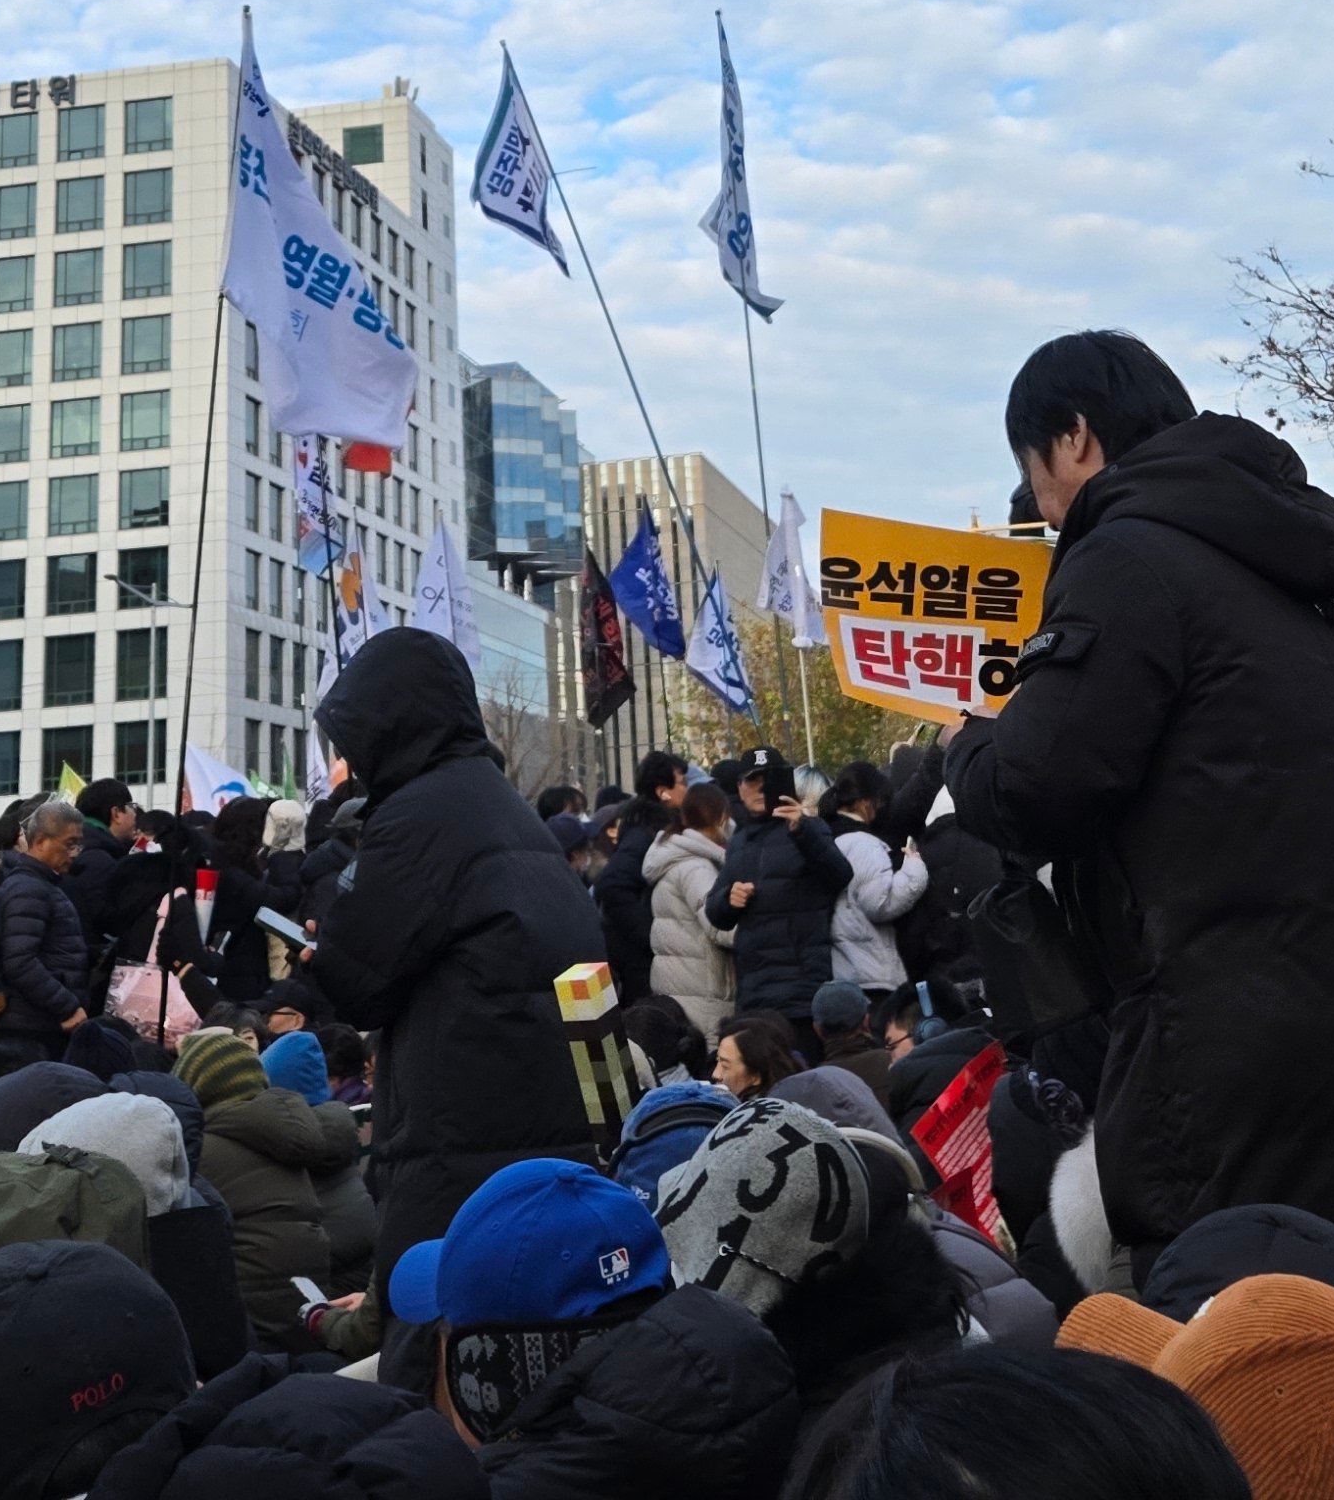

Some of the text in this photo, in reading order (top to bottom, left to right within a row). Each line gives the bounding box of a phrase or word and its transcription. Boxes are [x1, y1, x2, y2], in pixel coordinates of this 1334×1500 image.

[820, 557, 1023, 622] 윤석열을
[606, 1270, 630, 1286] MLB
[70, 1372, 124, 1413] POLO
